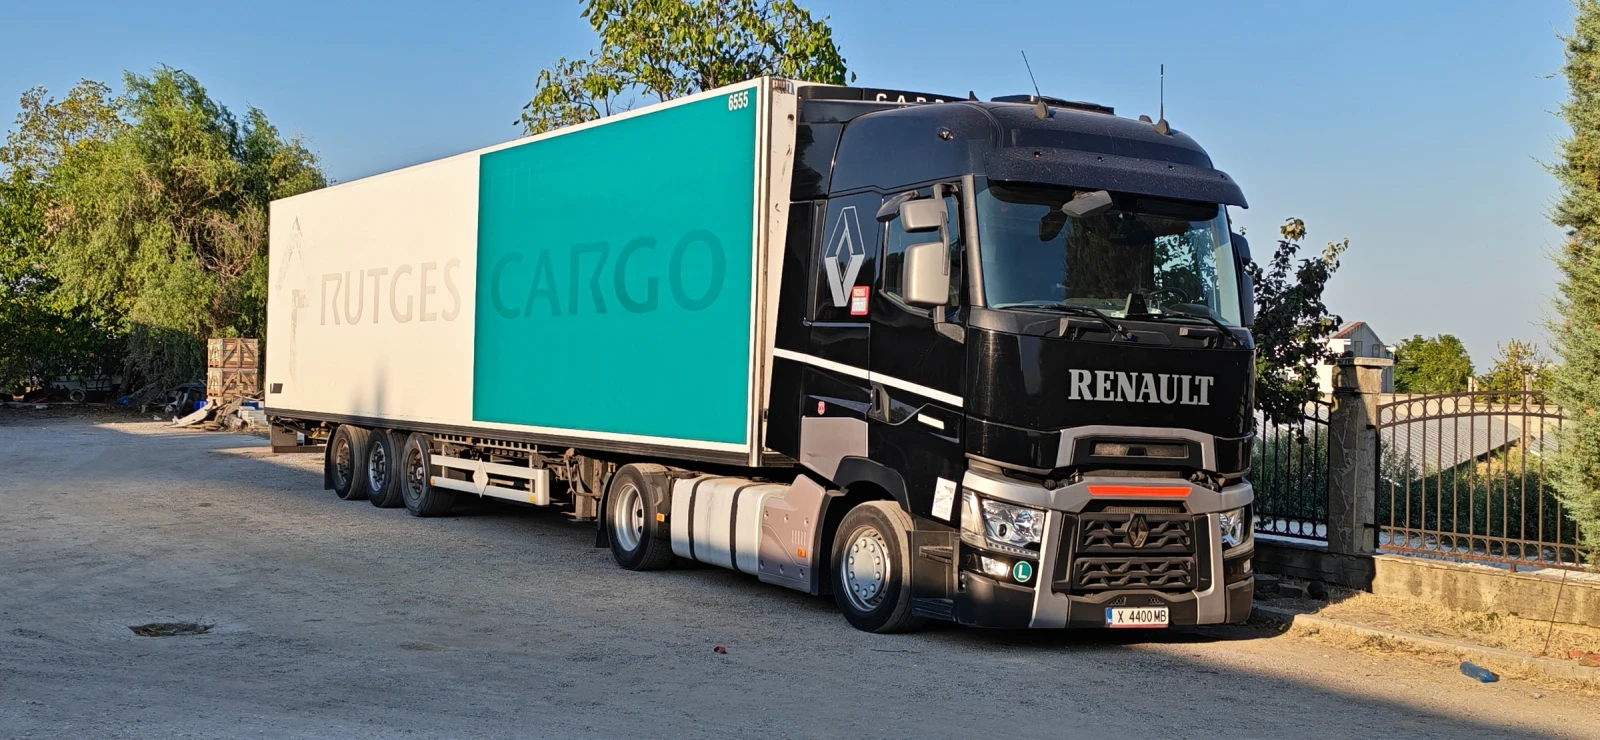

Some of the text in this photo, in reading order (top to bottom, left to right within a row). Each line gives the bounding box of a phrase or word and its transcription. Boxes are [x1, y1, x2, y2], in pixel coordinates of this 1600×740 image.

[728, 90, 749, 111] 6555
[876, 92, 945, 104] CA
[320, 227, 727, 326] RUTGES CARGO
[1068, 368, 1214, 406] RENAULT
[1018, 564, 1028, 579] L
[1117, 610, 1125, 623] X
